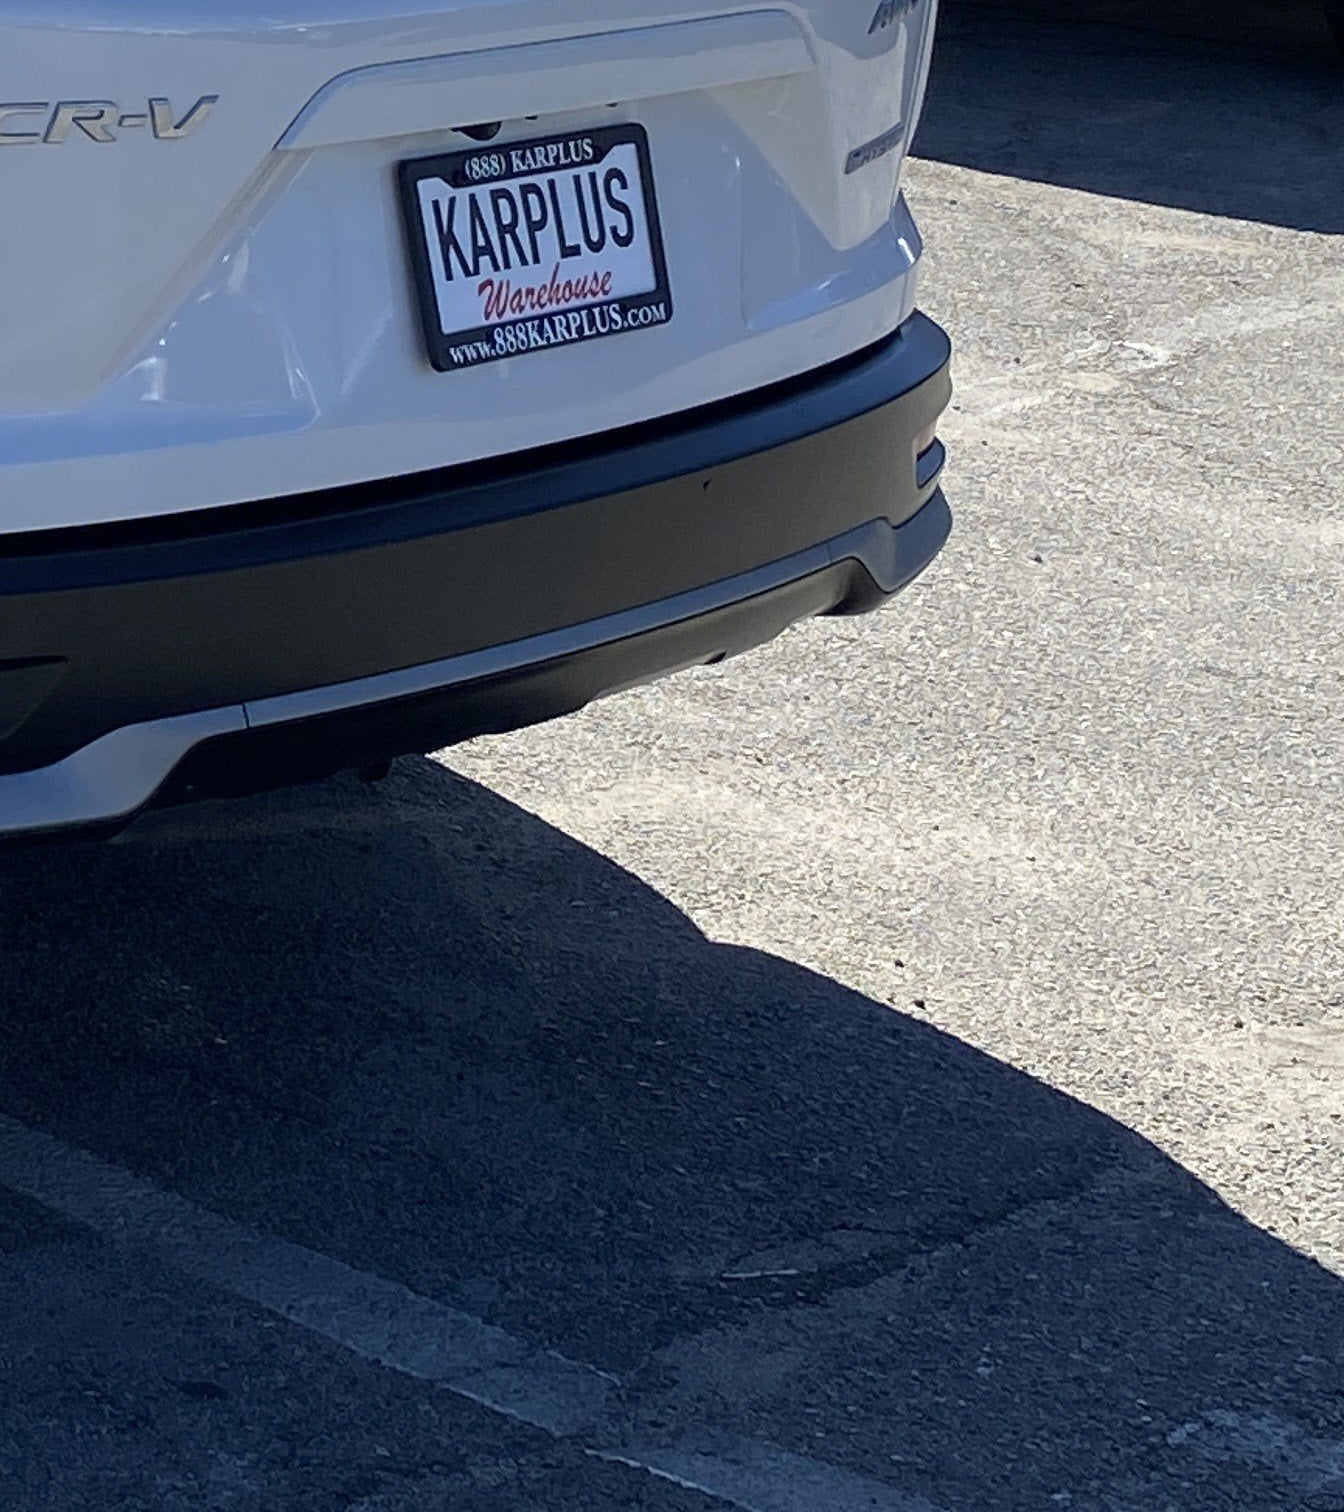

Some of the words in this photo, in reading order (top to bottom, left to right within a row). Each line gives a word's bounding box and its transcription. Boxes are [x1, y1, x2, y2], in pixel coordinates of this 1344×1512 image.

[465, 153, 507, 179] (888)
[511, 138, 594, 171] KARPLUS
[431, 167, 635, 282] KARPLUS
[477, 262, 614, 321] Warehouse
